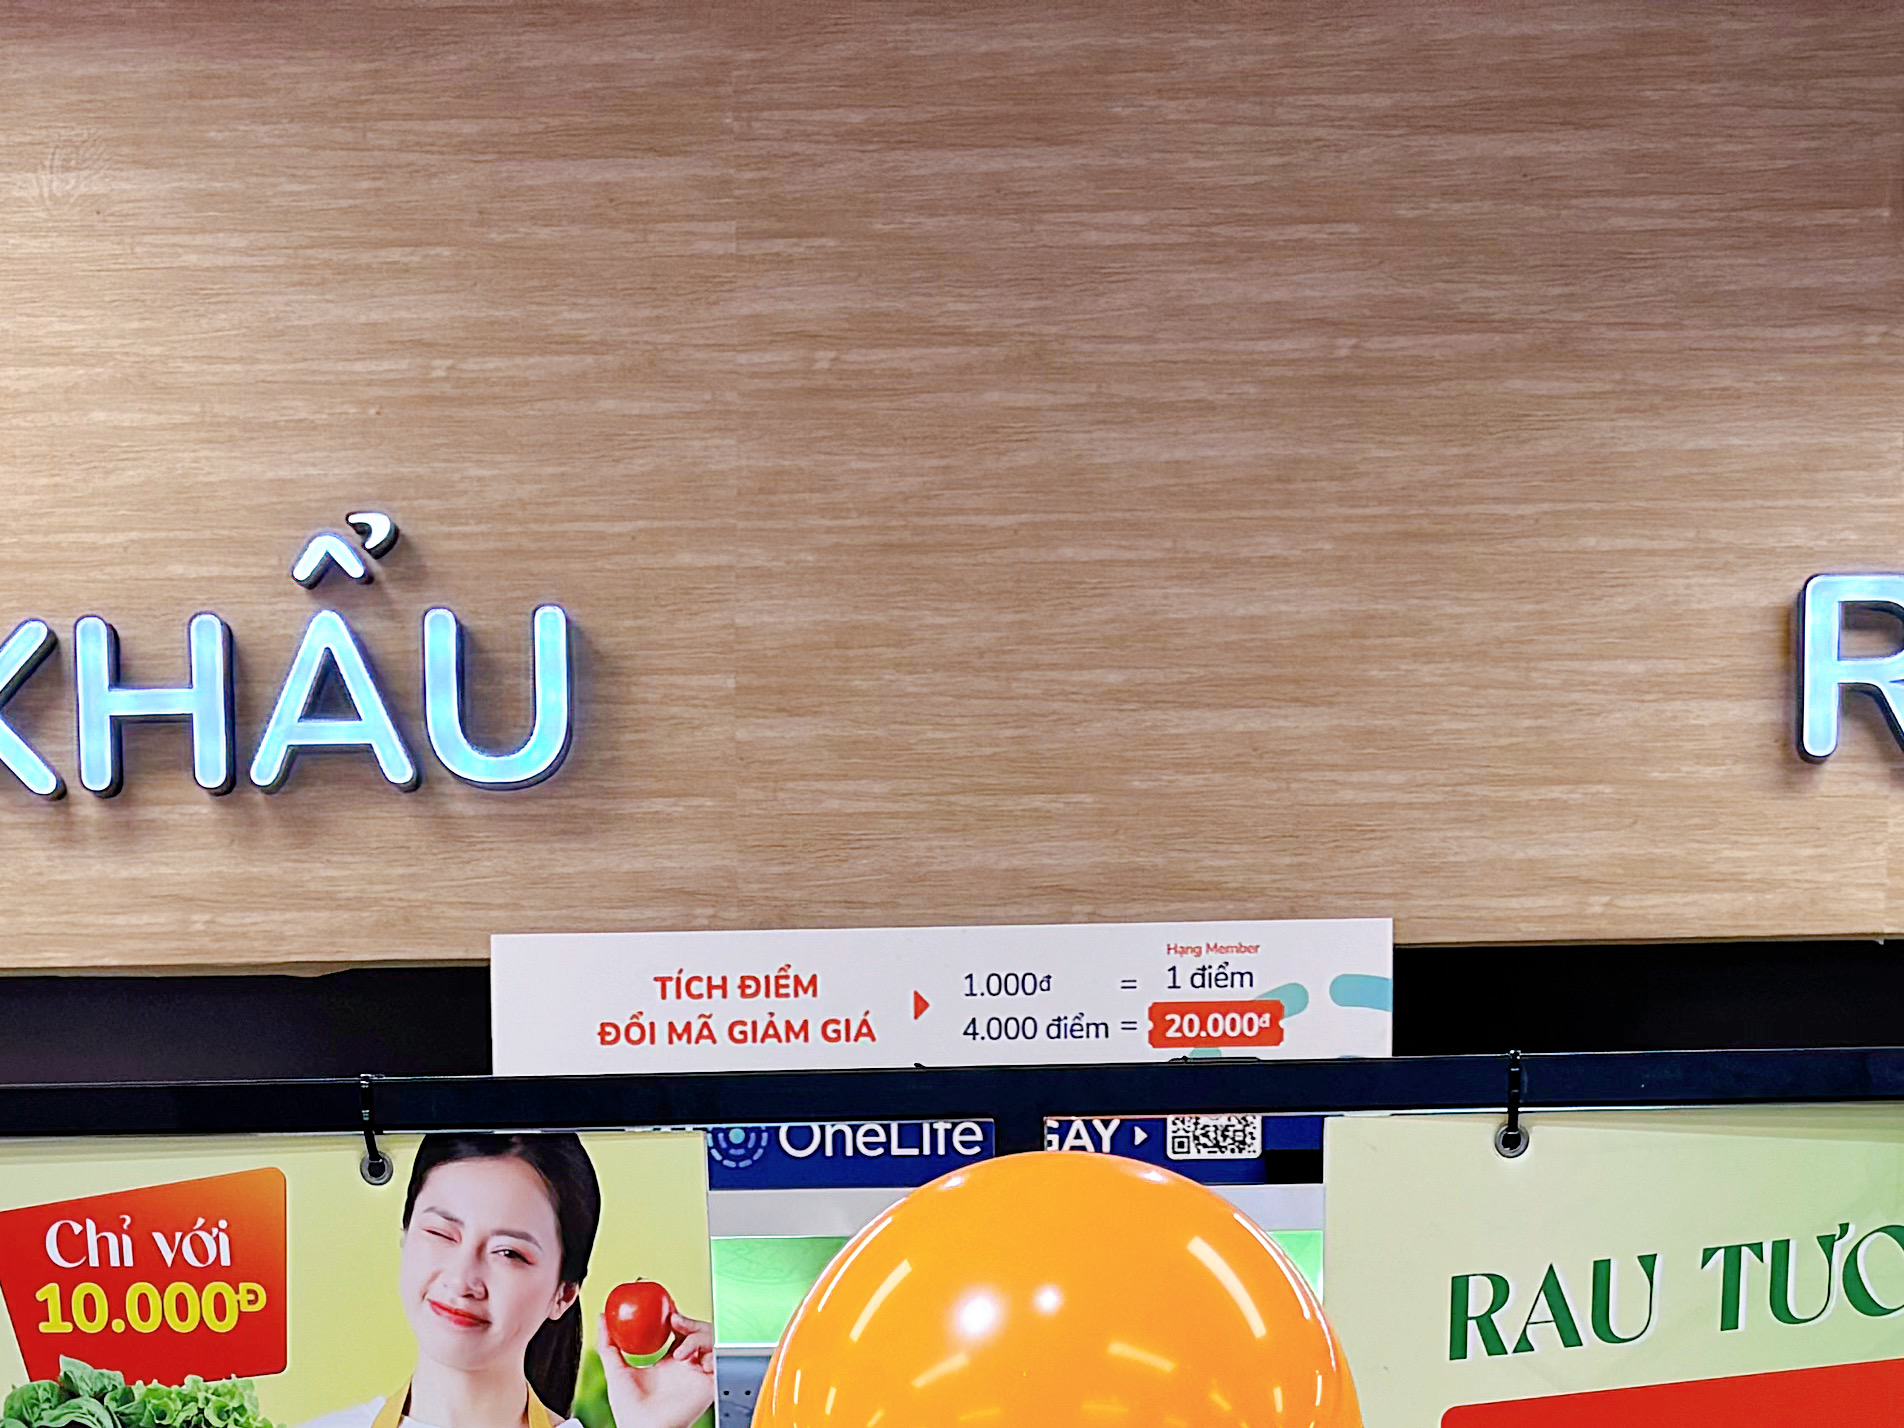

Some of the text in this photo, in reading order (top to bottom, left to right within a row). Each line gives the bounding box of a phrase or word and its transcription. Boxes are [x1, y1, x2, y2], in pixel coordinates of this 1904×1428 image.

[1165, 940, 1260, 958] Hạng Member
[653, 964, 820, 1002] TÍCH ĐIỂM
[962, 968, 1053, 999] 1.000đ
[1165, 961, 1255, 992] 1 điểm
[596, 1008, 877, 1048] ĐỔI MÃ GIẢM GIÁ
[962, 1012, 1110, 1042] 4.000 điểm
[43, 1215, 232, 1270] Chỉ với
[1448, 1252, 1658, 1362] RAU
